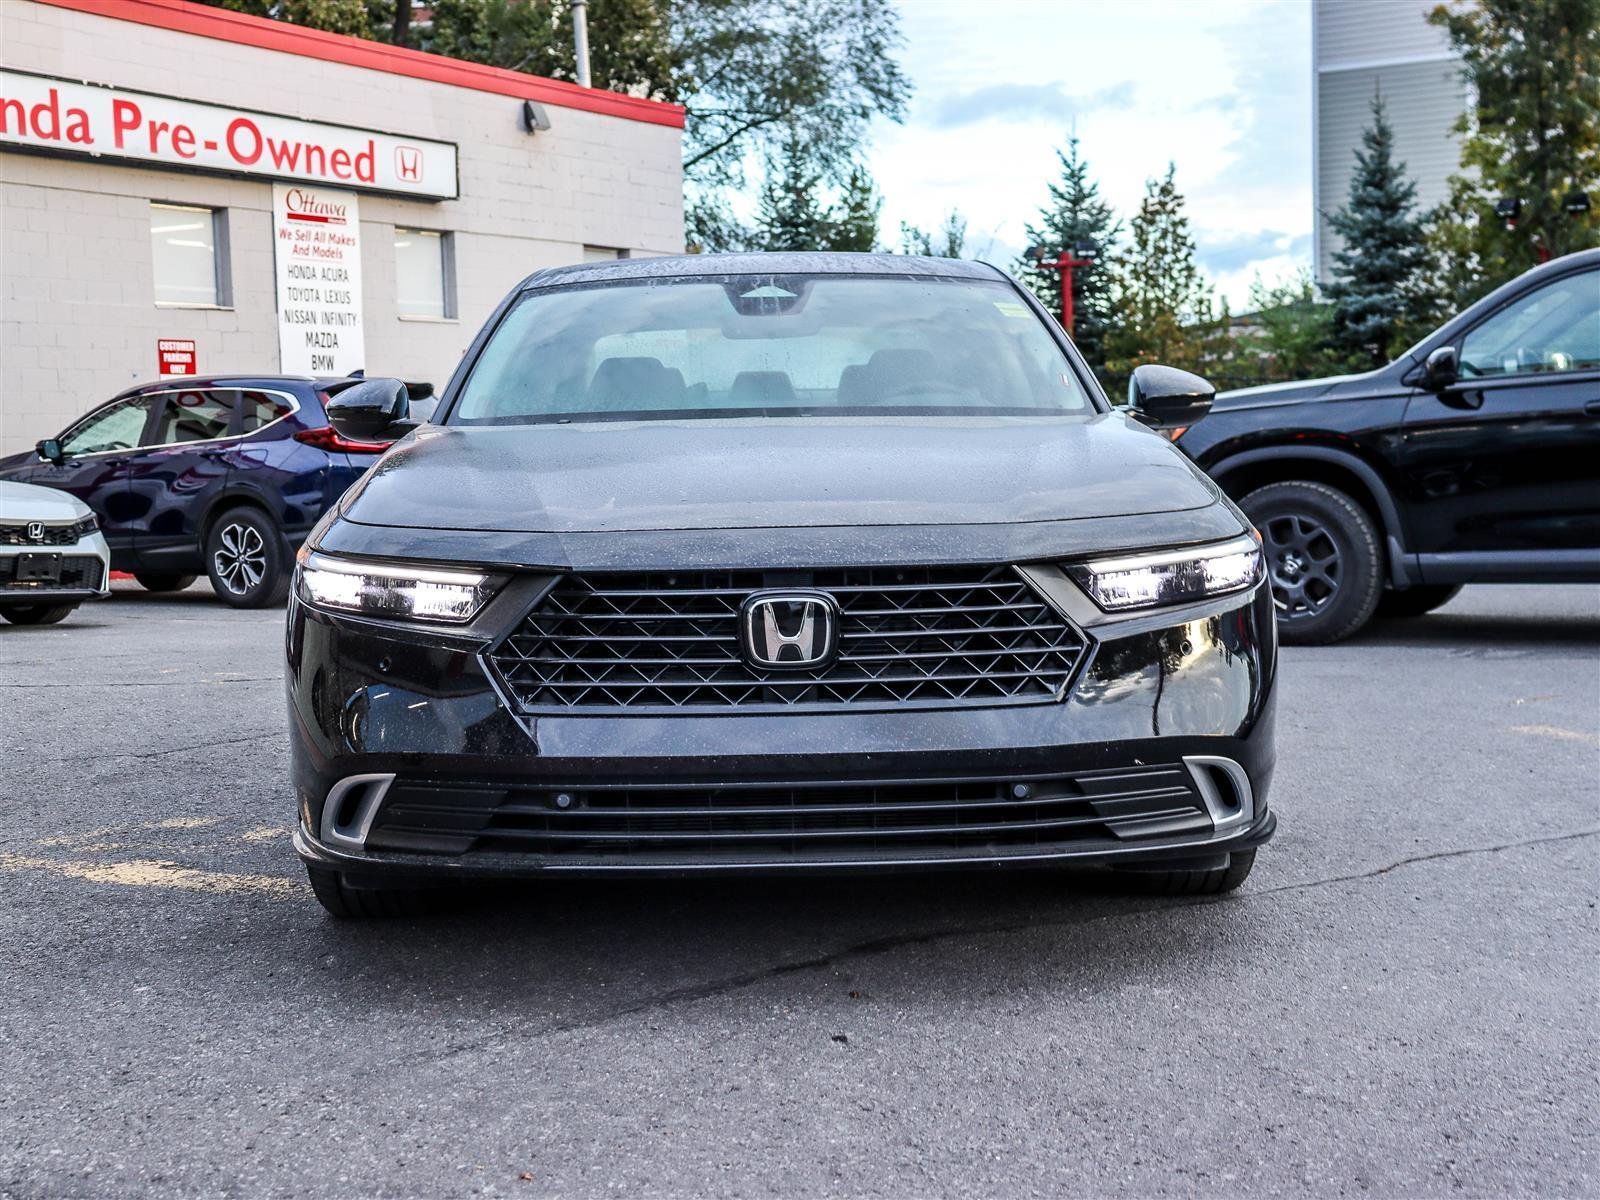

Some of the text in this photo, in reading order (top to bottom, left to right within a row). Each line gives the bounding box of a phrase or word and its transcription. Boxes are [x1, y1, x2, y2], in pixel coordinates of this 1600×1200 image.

[112, 98, 375, 183] Pre-Owned
[286, 187, 347, 217] Ottawa
[279, 228, 356, 247] We Sell All Makes
[292, 243, 344, 260] And Models
[287, 264, 349, 283] HONDA ACURA
[287, 286, 352, 305] TOYOTA LEXUS
[284, 309, 357, 327] NISSAN INFINITY
[305, 331, 340, 349] MAZDA
[311, 354, 335, 371] BMW
